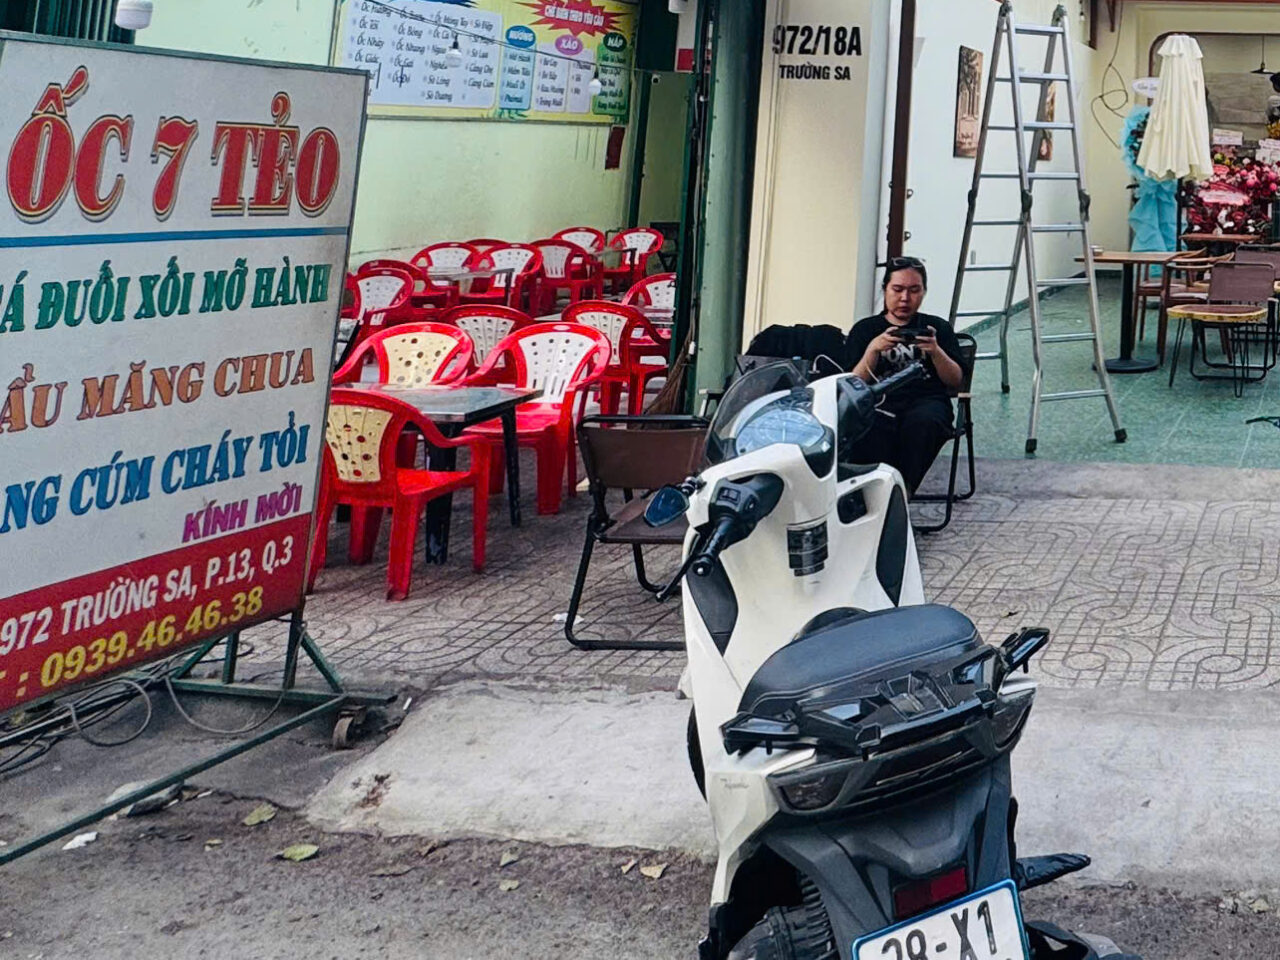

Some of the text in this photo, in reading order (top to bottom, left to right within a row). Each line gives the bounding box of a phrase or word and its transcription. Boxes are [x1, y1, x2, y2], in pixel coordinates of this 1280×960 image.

[772, 25, 862, 56] 972/18A
[779, 61, 851, 80] TRƯỜNG SA
[6, 65, 341, 224] ỐC 7 TẺO
[0, 270, 28, 333] Á
[199, 257, 248, 313] MỠ
[251, 256, 332, 309] HÀNH
[0, 347, 315, 434] ẨU MĂNG CHUA
[0, 411, 311, 534] NG CÚM CHÁY TỎI
[182, 481, 303, 541] KÍNH MỜI
[0, 535, 294, 657] 972 TRƯỜNG SA, P.13, Q.3
[40, 586, 264, 688] 0939.46.46.38
